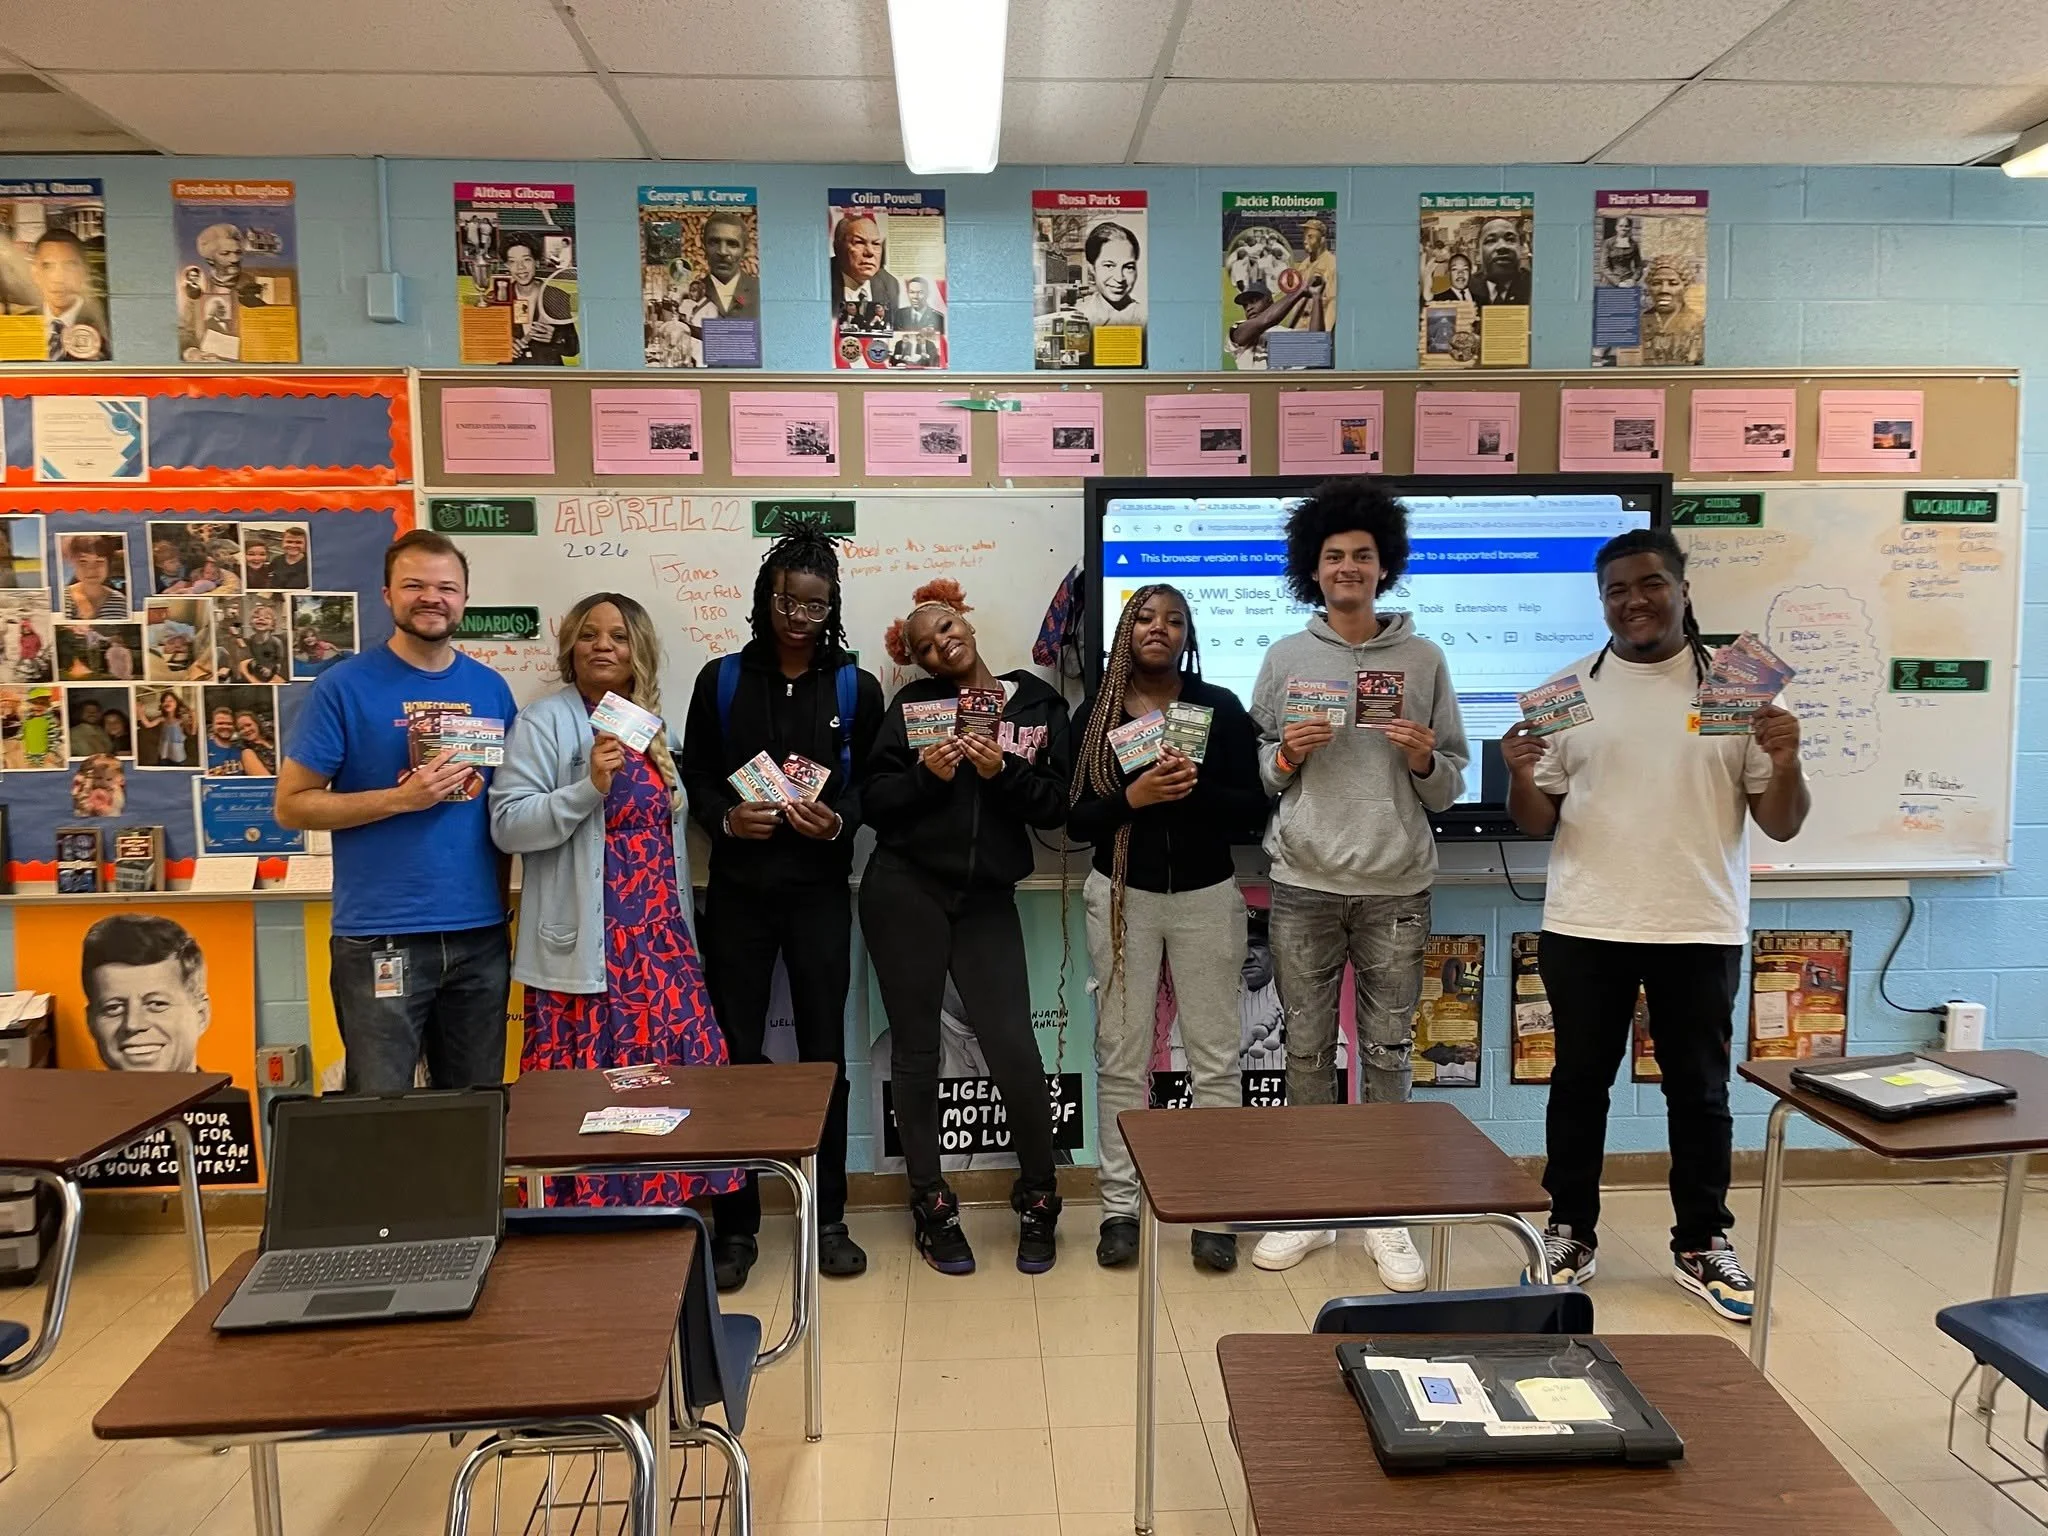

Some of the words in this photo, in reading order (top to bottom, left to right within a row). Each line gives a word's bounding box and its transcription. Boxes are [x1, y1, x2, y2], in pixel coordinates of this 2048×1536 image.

[176, 184, 233, 196] Frederick
[235, 184, 289, 198] Douglass
[473, 186, 512, 198] Althea
[514, 187, 555, 199] Gibson
[647, 189, 689, 204] George
[708, 190, 747, 202] Carver
[851, 192, 881, 204] Colin
[883, 193, 922, 204] Powell
[1057, 193, 1086, 205] Rosa
[1089, 194, 1120, 205] Parks
[1235, 195, 1269, 207] Jackie
[1271, 195, 1324, 207] Robinson
[1469, 196, 1498, 208] Luther
[1500, 196, 1521, 210] King
[465, 505, 510, 528] DATE:
[555, 496, 706, 536] APRIL
[563, 542, 629, 558] 2026
[842, 539, 880, 558] Based
[886, 546, 899, 555] on
[1140, 552, 1161, 563] This
[1162, 552, 1201, 563] browser
[1202, 552, 1239, 562] version
[1240, 552, 1248, 562] is
[1249, 553, 1263, 562] no
[1264, 552, 1288, 565] long
[1426, 552, 1437, 561] to
[1438, 553, 1445, 561] a
[1446, 551, 1497, 562] supported
[1498, 550, 1539, 560] browser.
[662, 562, 719, 583] James
[676, 584, 742, 602] Garfield
[693, 605, 728, 621] 1880
[1209, 606, 1235, 615] View
[1245, 606, 1274, 615] Insert
[1418, 603, 1444, 613] Tools
[1455, 603, 1508, 613] Extensions
[1519, 602, 1541, 614] Help
[457, 612, 534, 634] ANDARD(S):
[1535, 632, 1594, 641] Background
[1298, 681, 1327, 689] POWER
[1712, 687, 1746, 696] POWER
[1318, 693, 1341, 702] VOTE
[1552, 692, 1577, 704] VOTE
[1736, 700, 1763, 708] VOTE
[912, 702, 942, 713] POWER
[1296, 704, 1316, 712] CITY
[451, 718, 483, 727] POWER
[936, 712, 957, 721] VOTE
[1711, 713, 1734, 721] CITY
[917, 726, 936, 735] CITY
[1116, 720, 1145, 737] POWER
[475, 732, 497, 740] VOTE
[452, 743, 473, 751] CITY
[1127, 744, 1145, 757] CITY
[745, 774, 762, 793] CITY
[1032, 1009, 1069, 1020] NJAMIN
[1033, 1019, 1068, 1030] ANKLN
[938, 1080, 1002, 1102] LIGEN
[1249, 1078, 1282, 1093] LET
[183, 1112, 230, 1127] YOUR
[942, 1104, 1007, 1129] MOTH
[1050, 1102, 1077, 1123] OF
[143, 1130, 166, 1144] AN
[199, 1128, 234, 1142] FOR
[981, 1129, 1011, 1147] LU
[124, 1145, 171, 1160] WHAT
[216, 1144, 249, 1158] CAN
[105, 1161, 152, 1177] YOUR
[157, 1159, 250, 1175] COTRY.”
